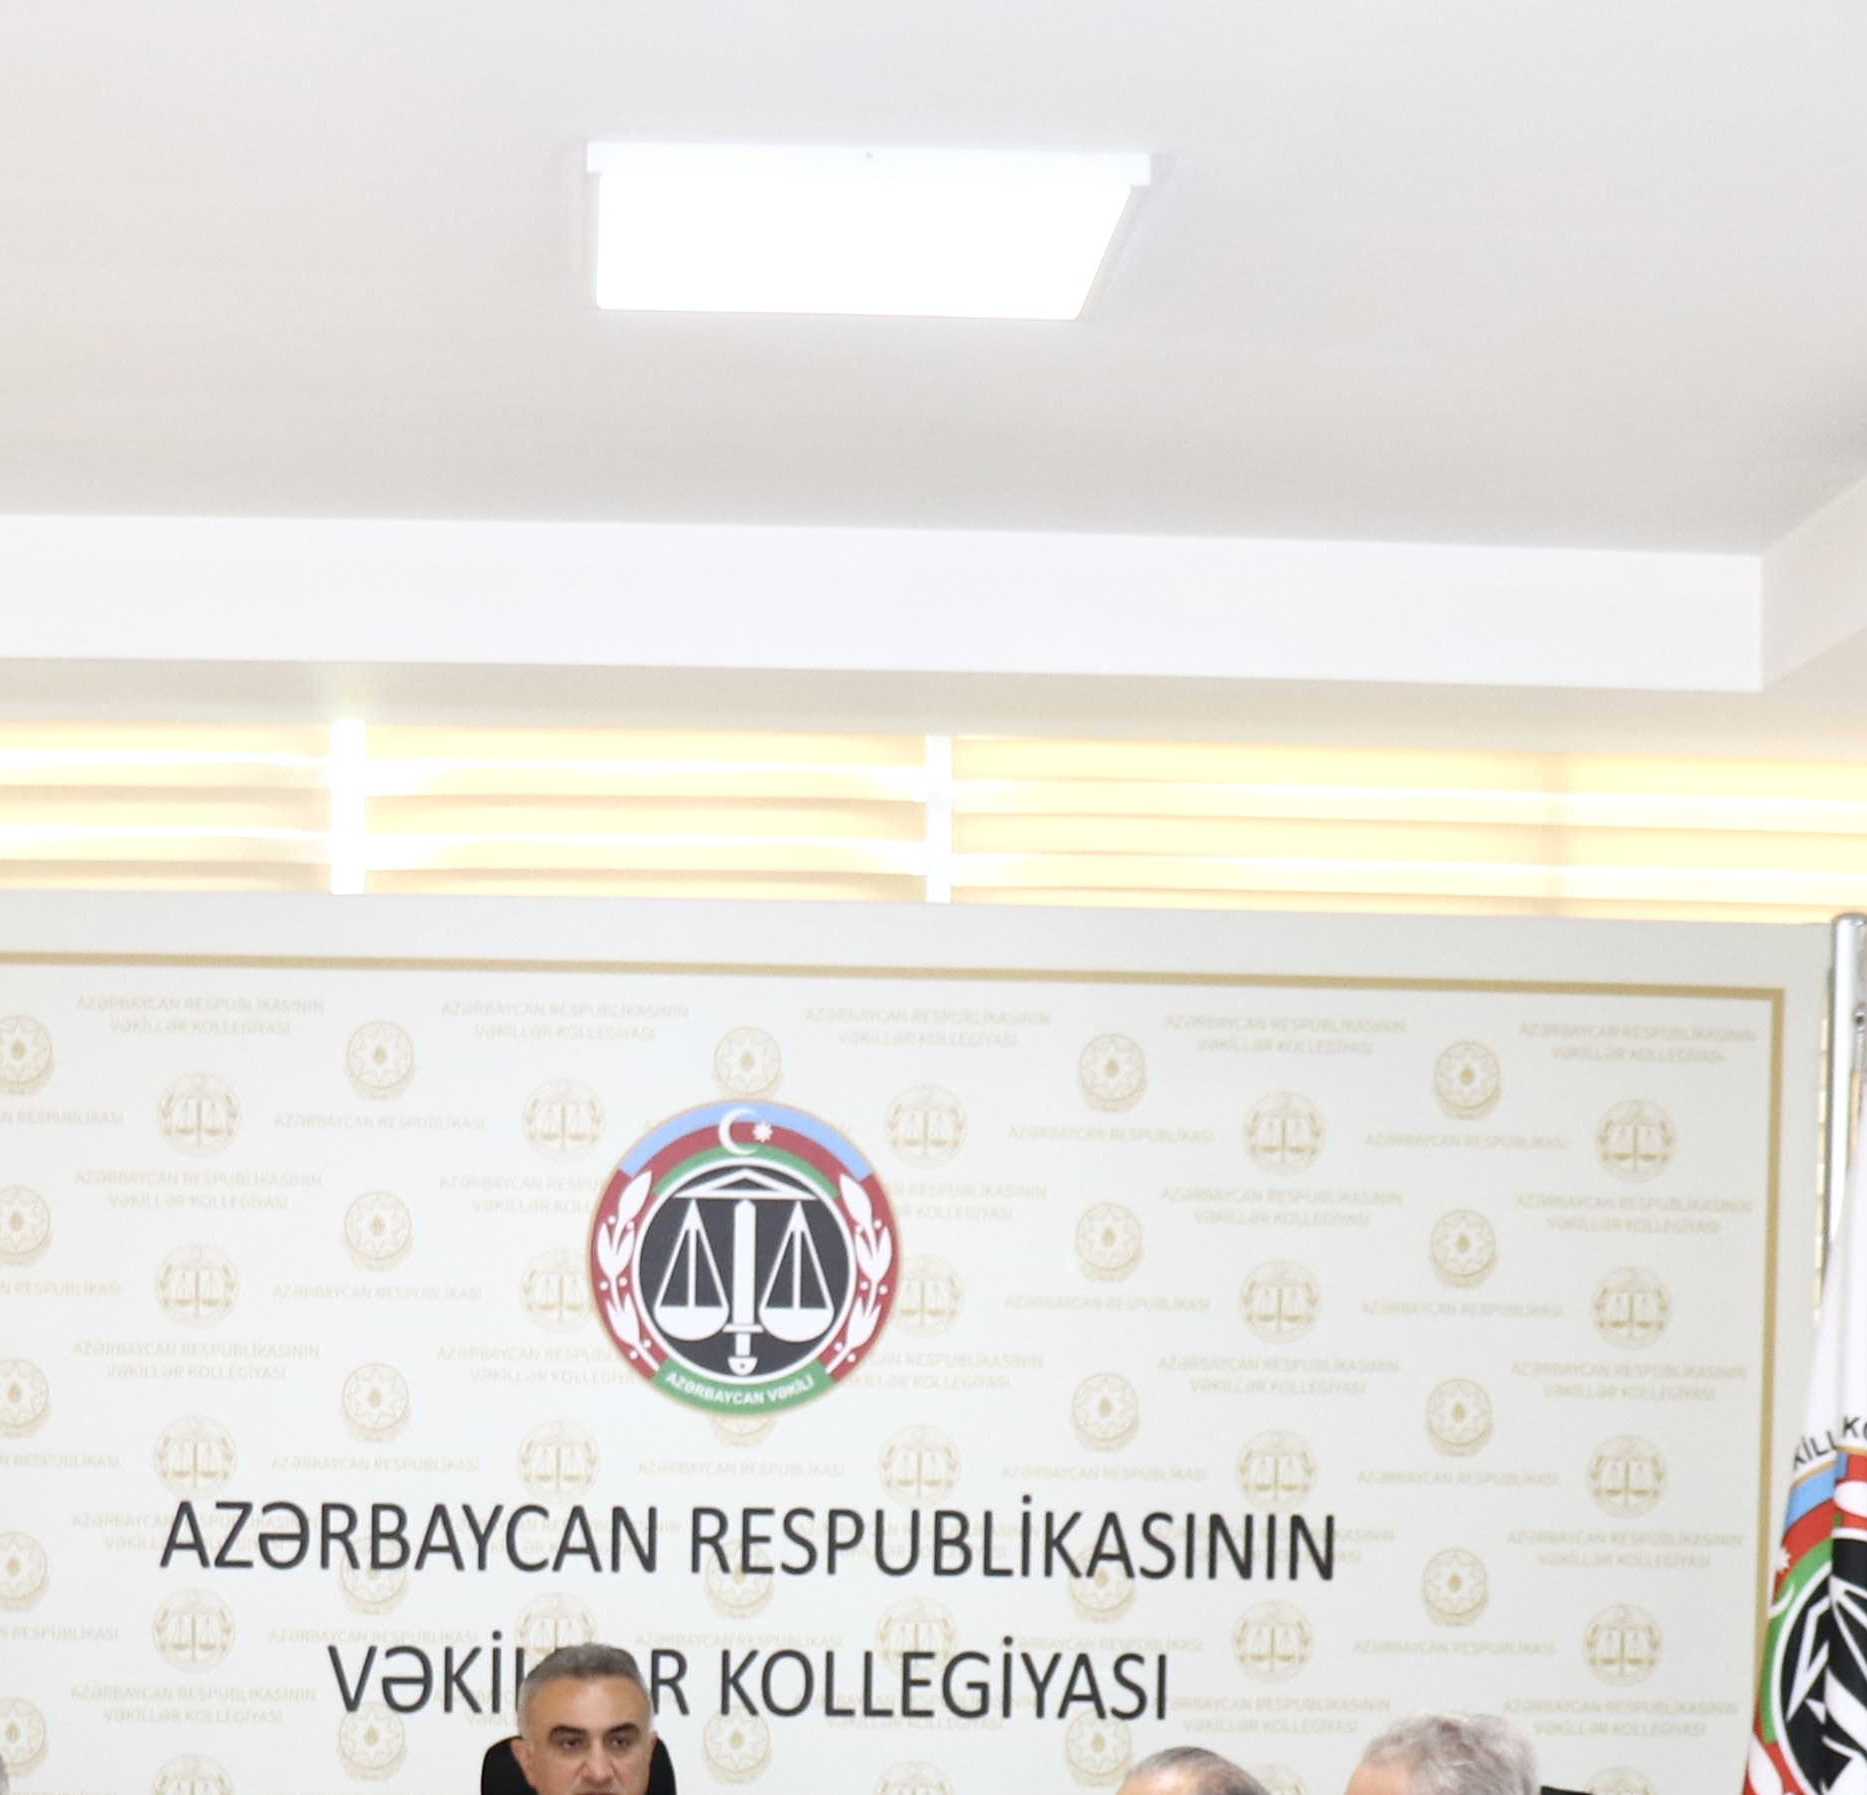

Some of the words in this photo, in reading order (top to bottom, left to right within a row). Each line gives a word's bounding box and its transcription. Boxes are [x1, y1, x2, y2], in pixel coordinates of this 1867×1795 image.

[664, 1371, 764, 1405] AZƏRBAYCAN
[160, 1500, 657, 1574] AZƏRBAYCAN
[690, 1494, 1335, 1581] RESPUBLİKASININ
[327, 1630, 690, 1716] VƏKİR
[719, 1636, 1169, 1721] KOLLEGİYASI
